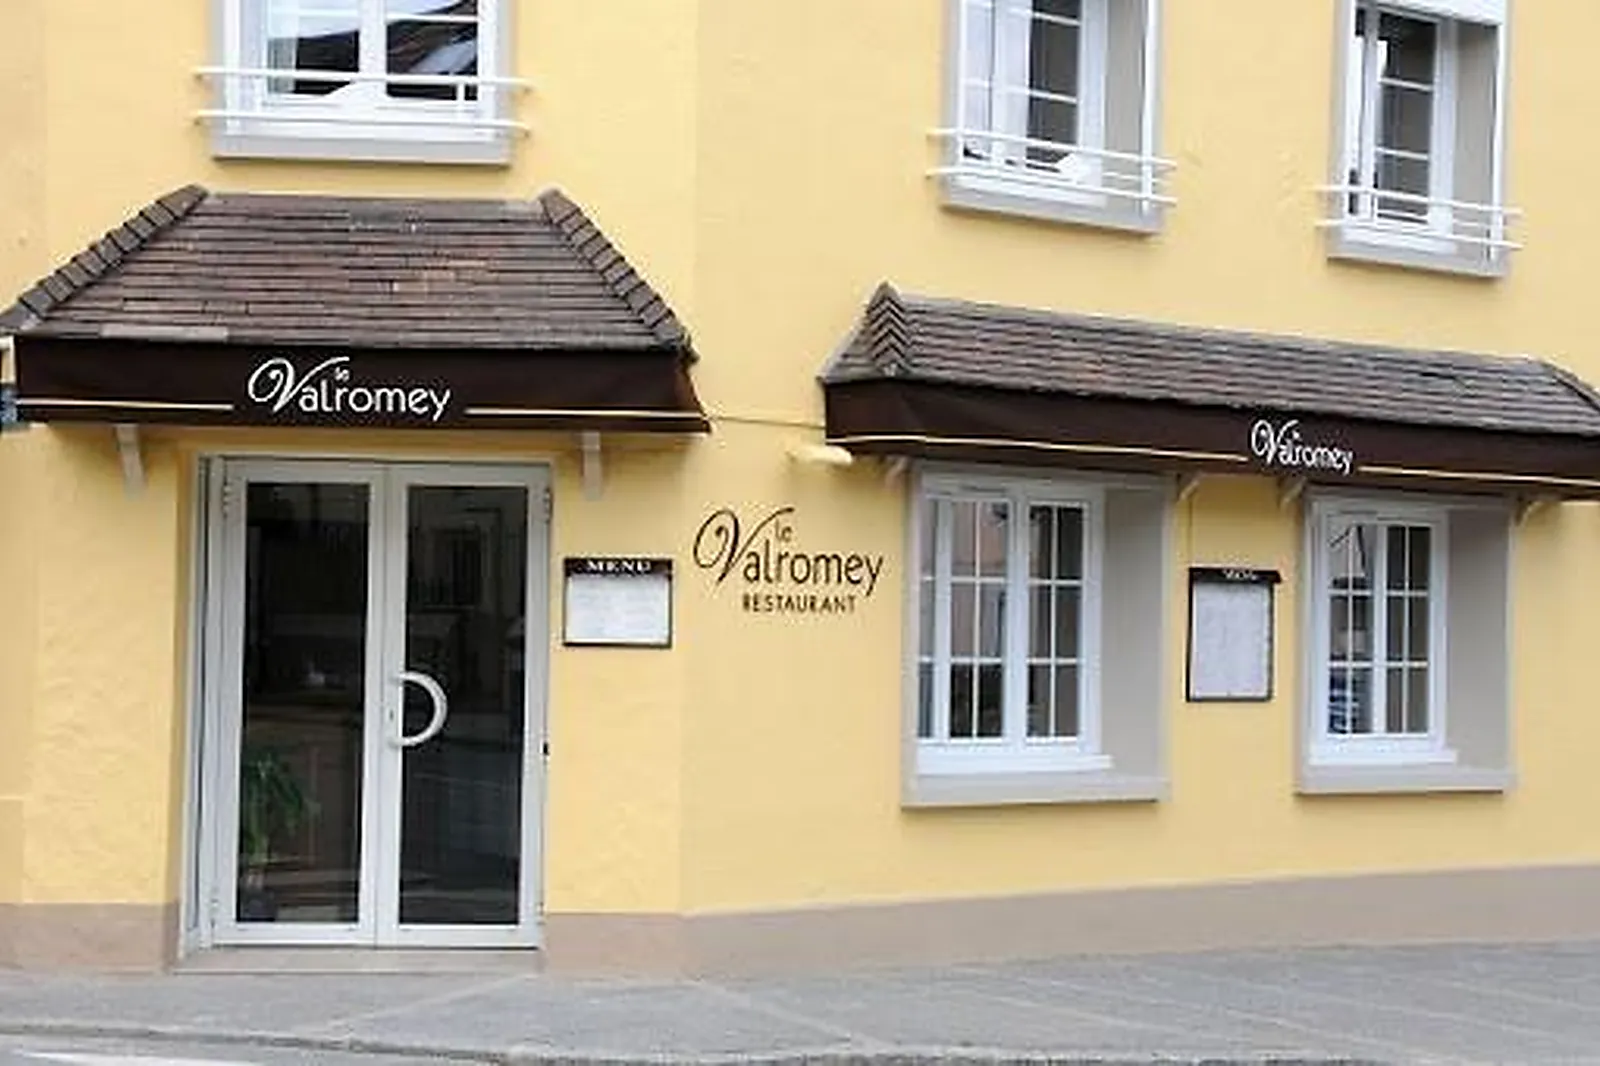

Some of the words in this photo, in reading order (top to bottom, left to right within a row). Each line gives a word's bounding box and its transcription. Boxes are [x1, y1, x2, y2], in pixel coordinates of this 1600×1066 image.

[247, 356, 451, 421] Valromey
[1251, 420, 1353, 475] Valromey
[774, 519, 794, 543] le
[586, 560, 652, 574] MENU
[692, 507, 884, 596] Valromey
[742, 595, 856, 613] RESTAURANT
